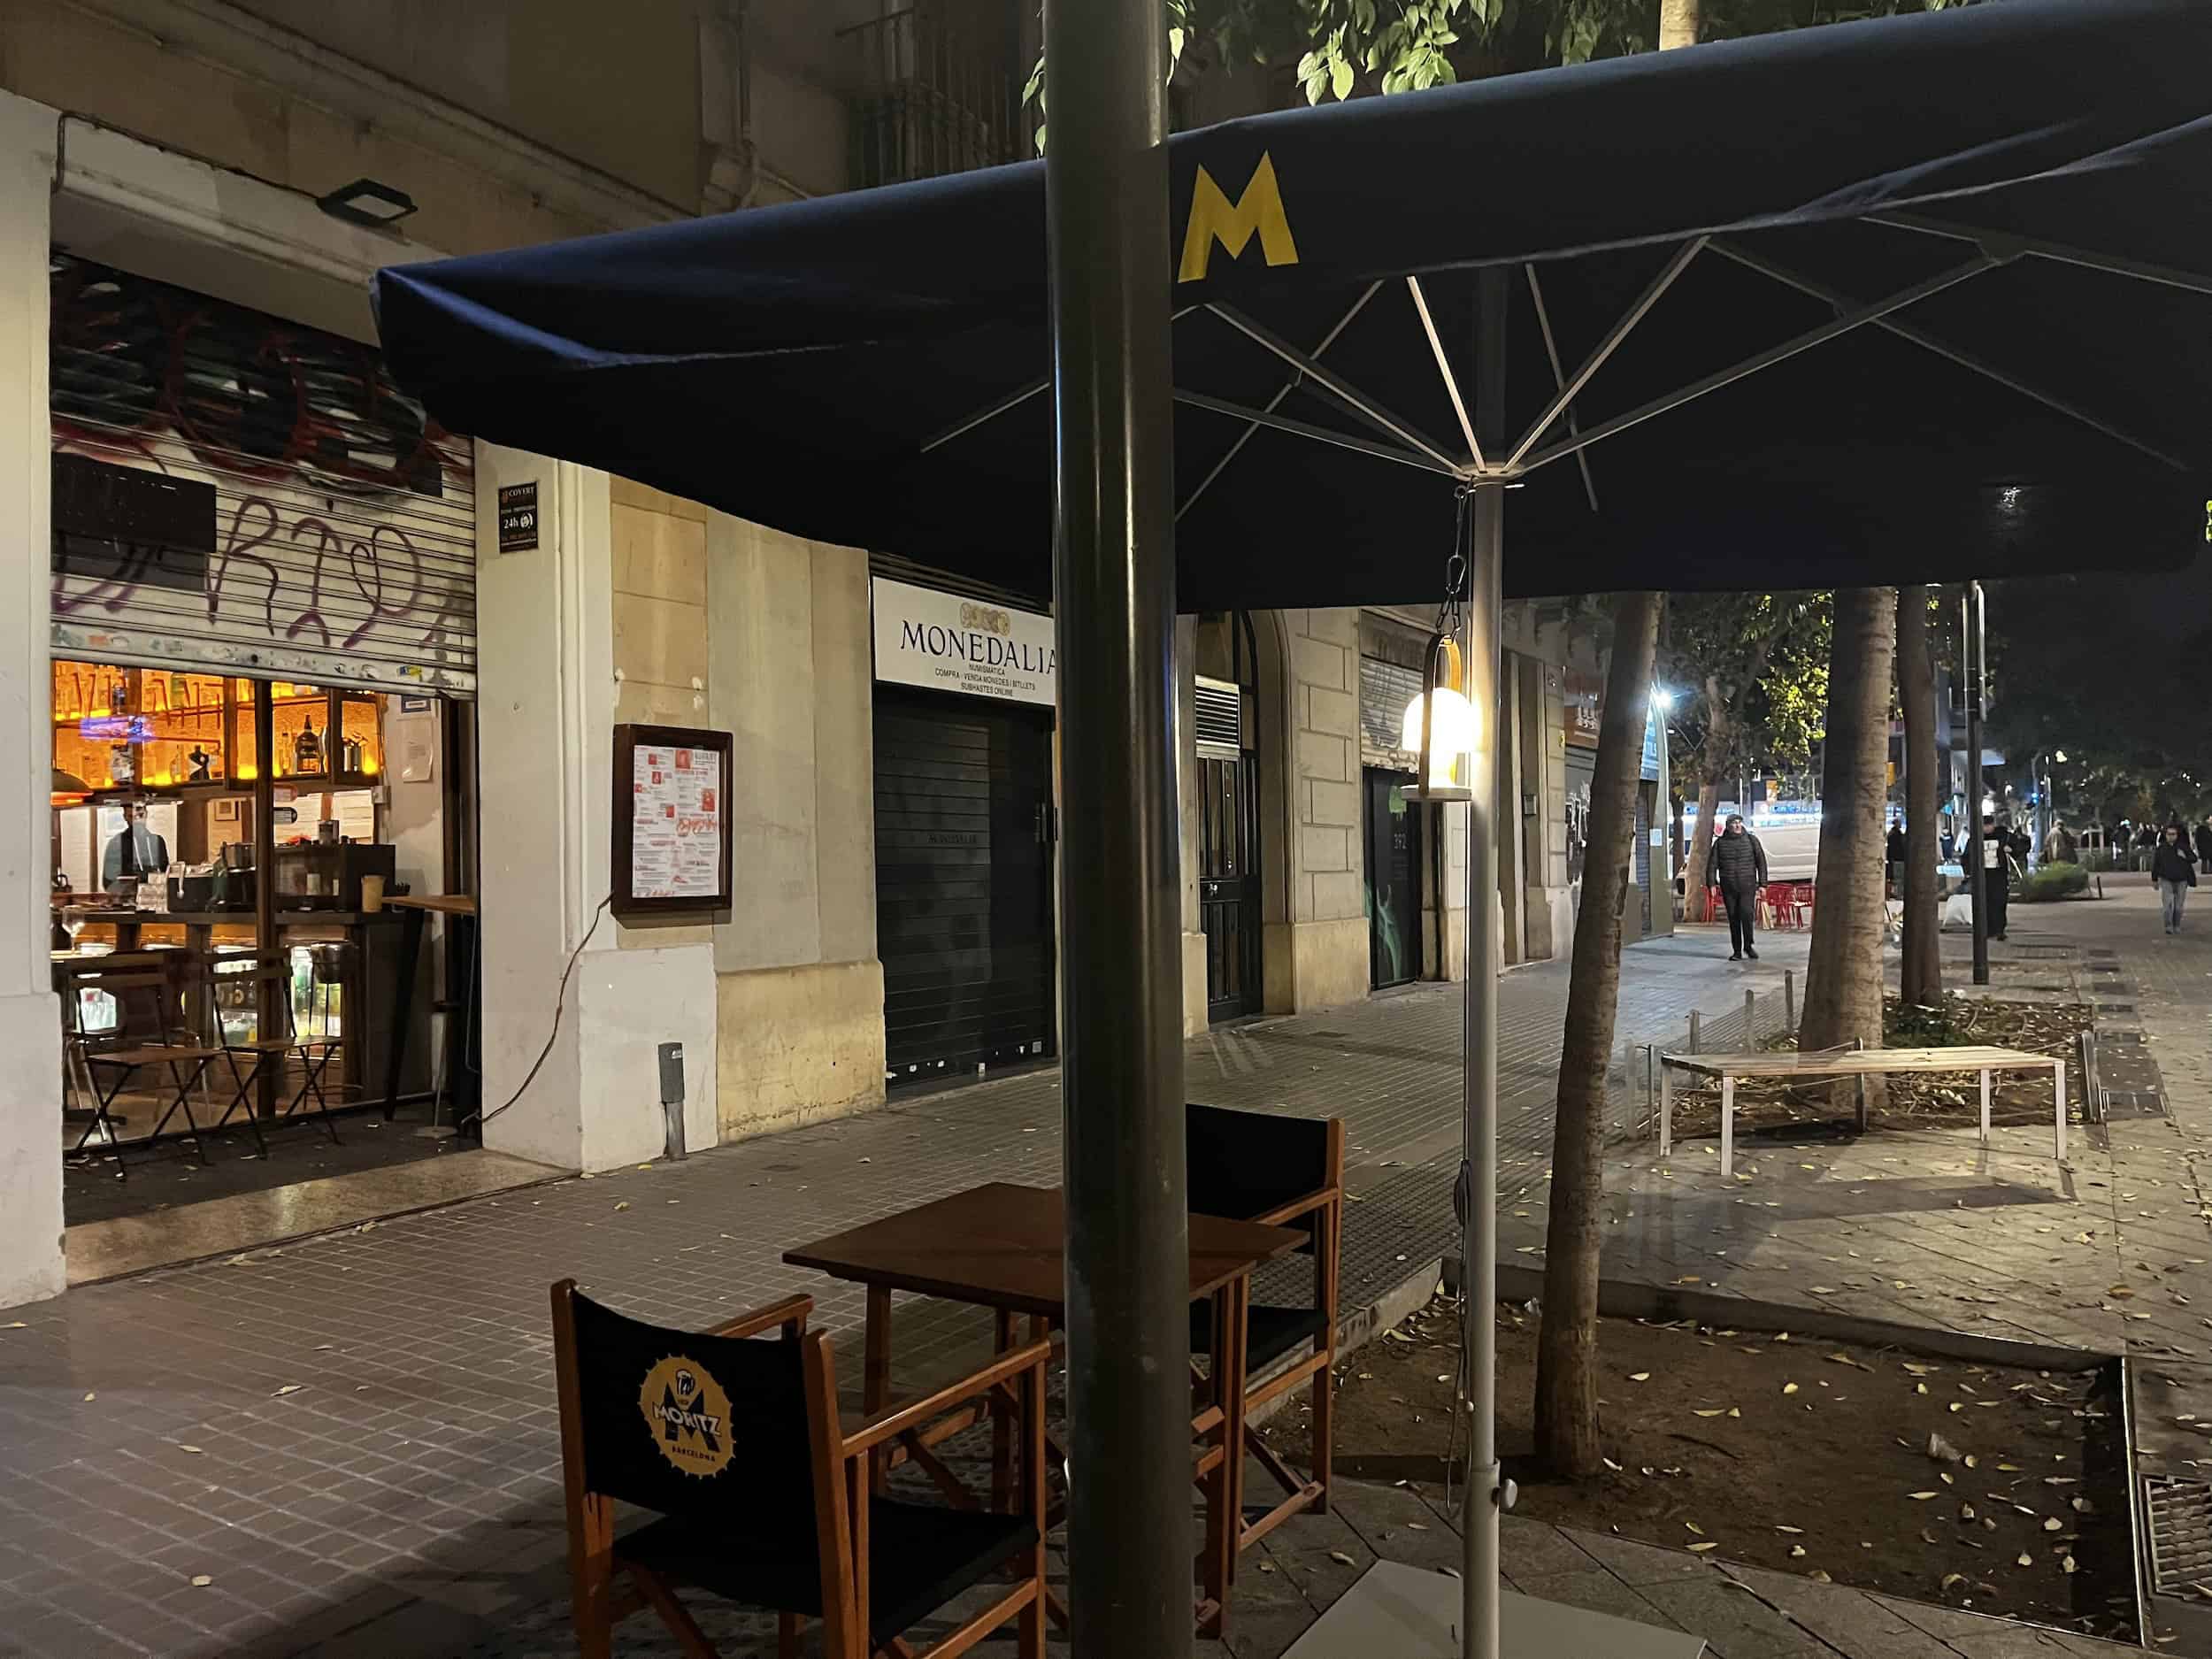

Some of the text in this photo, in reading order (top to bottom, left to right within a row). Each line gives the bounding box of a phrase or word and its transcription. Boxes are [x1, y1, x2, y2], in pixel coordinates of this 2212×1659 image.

[1178, 149, 1300, 283] M
[503, 516, 519, 530] 24h
[934, 667, 960, 679] COMPRA
[652, 1401, 722, 1438] MORITZ
[672, 1446, 716, 1463] BARCELONA
